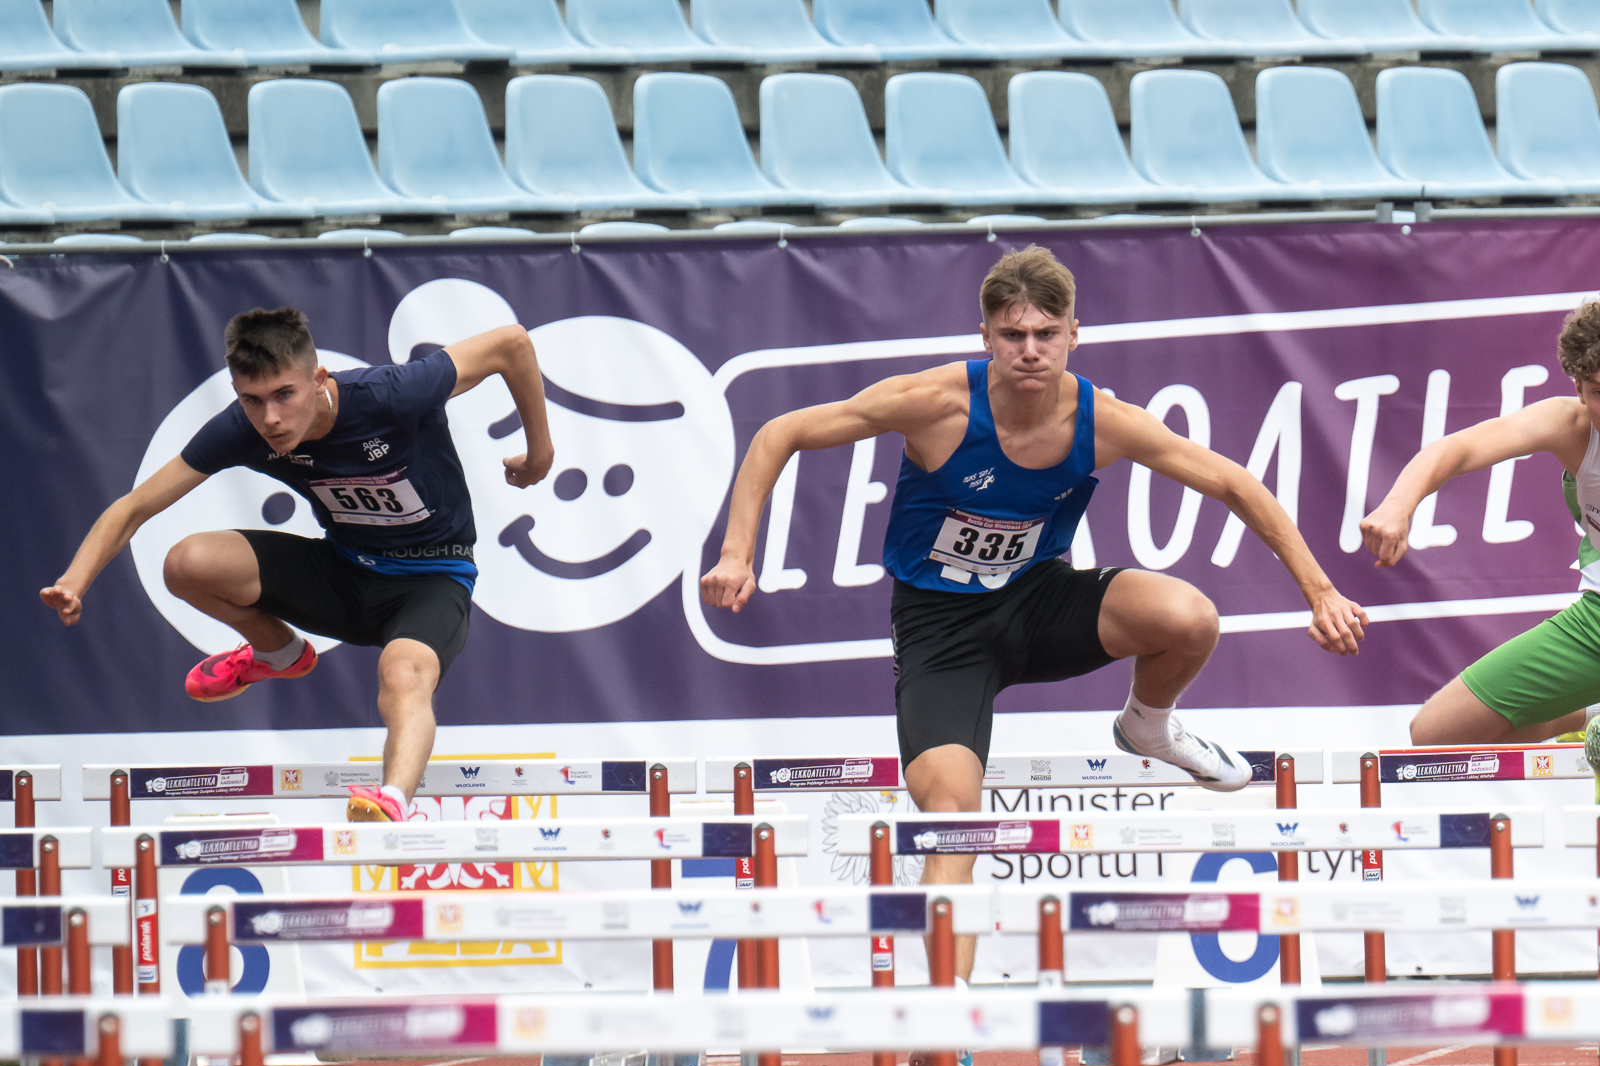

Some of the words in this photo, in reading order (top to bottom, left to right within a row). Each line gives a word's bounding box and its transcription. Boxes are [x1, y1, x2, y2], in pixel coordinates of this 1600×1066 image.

[367, 444, 390, 462] JBP
[329, 487, 404, 513] 563
[383, 545, 448, 558] ROUGH
[953, 527, 1028, 561] 335
[790, 767, 841, 779] LEKKOATLETYKA
[1417, 763, 1467, 776] LEKKOATLETYKA
[166, 776, 216, 789] LEKKOATLETYKA
[990, 787, 1175, 812] Minister
[937, 831, 995, 845] LEKKOATLETYKA
[140, 920, 154, 961] polanik
